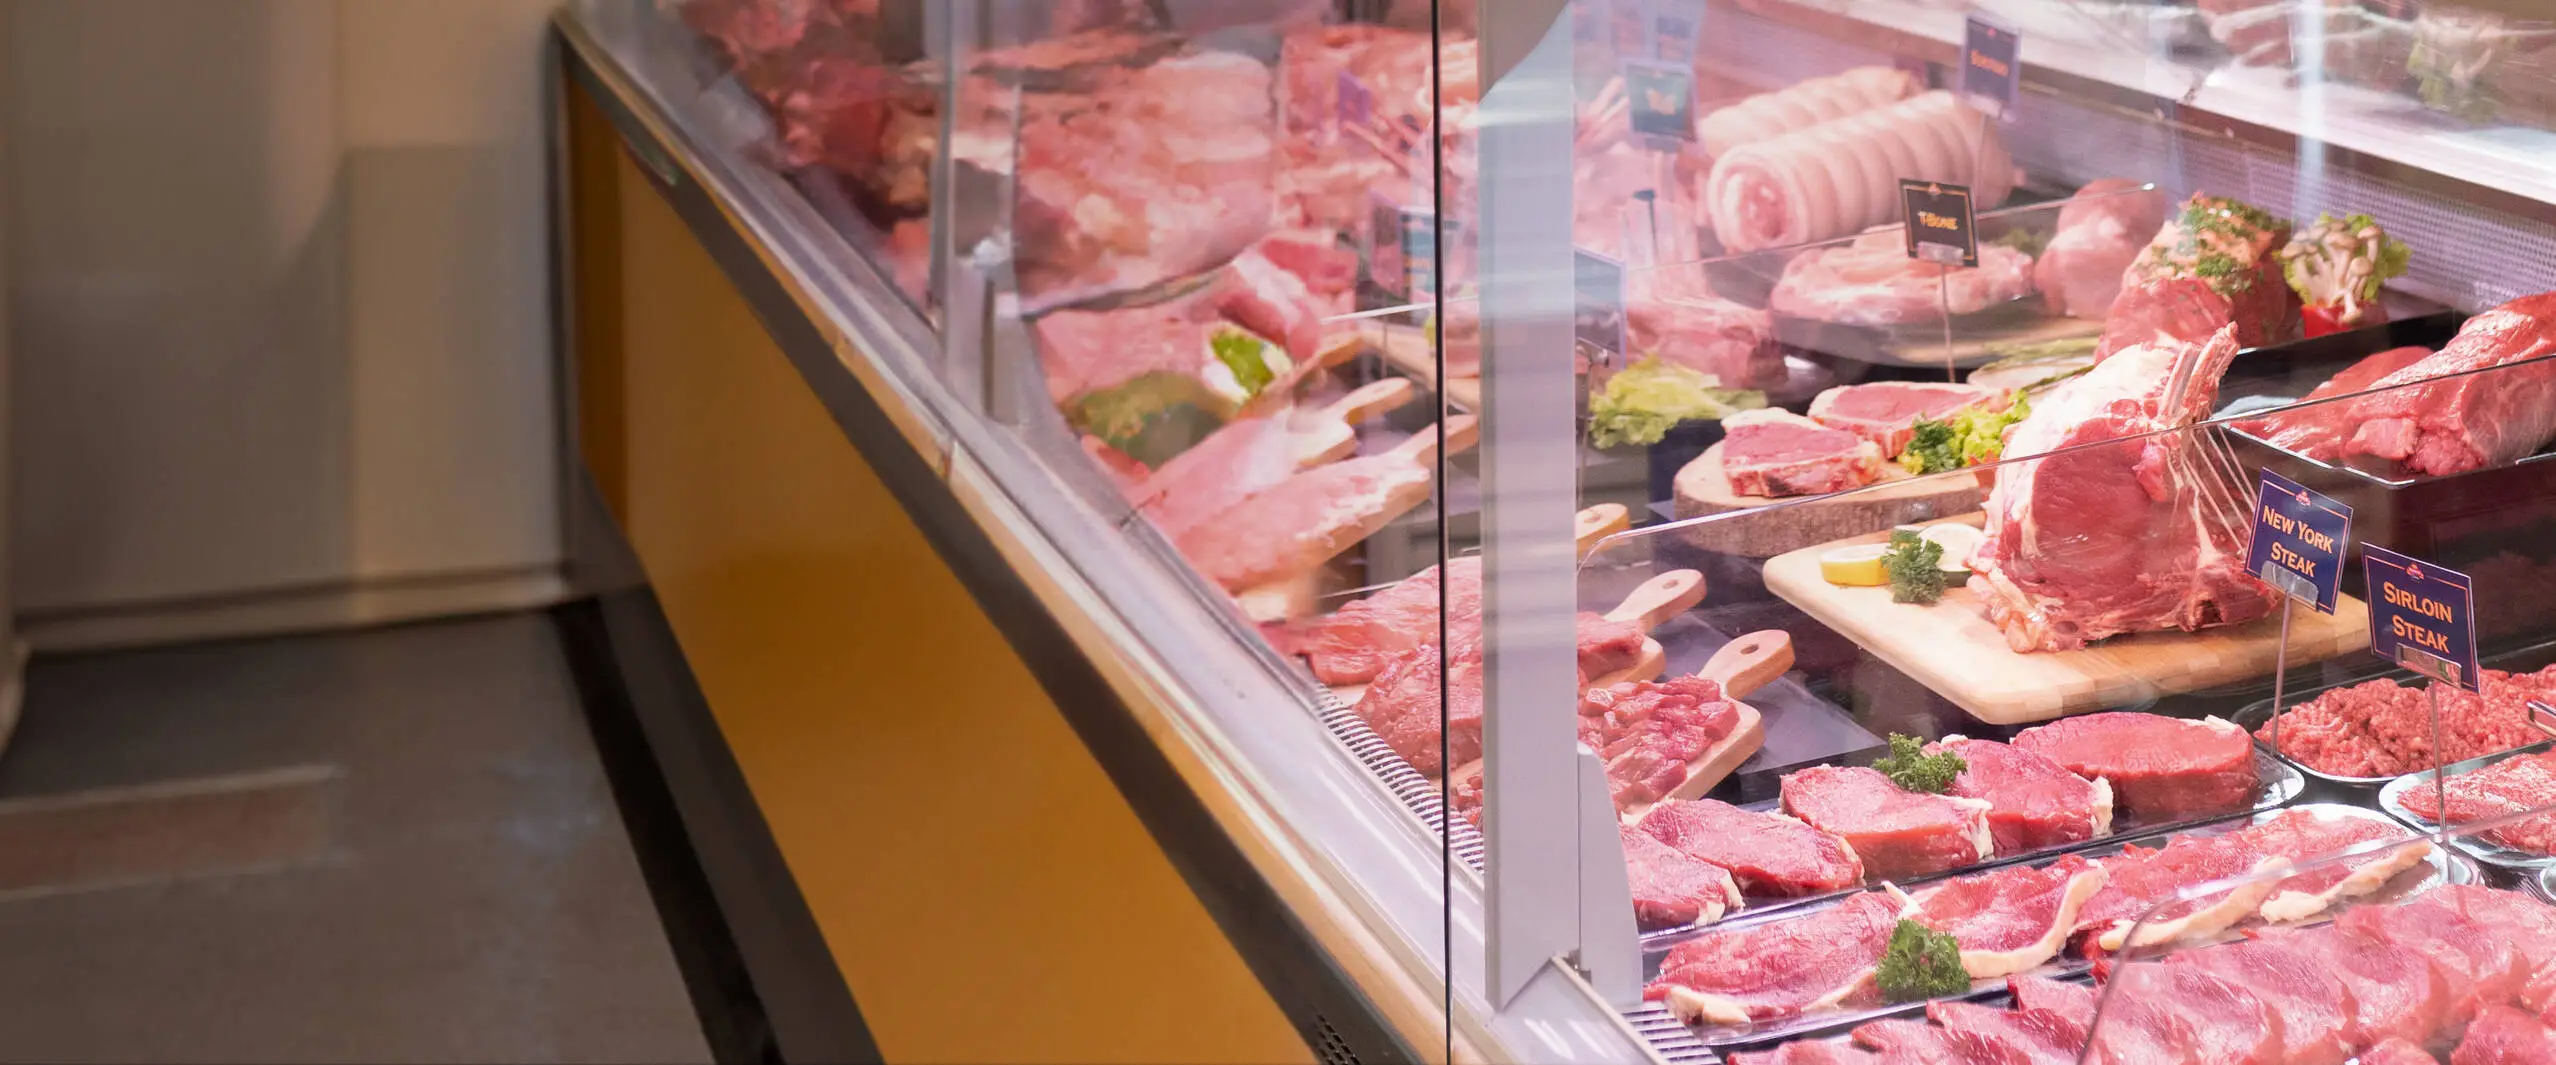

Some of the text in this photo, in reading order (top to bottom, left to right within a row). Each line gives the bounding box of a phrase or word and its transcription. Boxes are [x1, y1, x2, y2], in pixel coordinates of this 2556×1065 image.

[2262, 505, 2334, 554] NEW YORK
[2271, 542, 2316, 577] STEAK
[2383, 581, 2452, 623] SIRLOIN
[2392, 614, 2450, 654] STEAK
